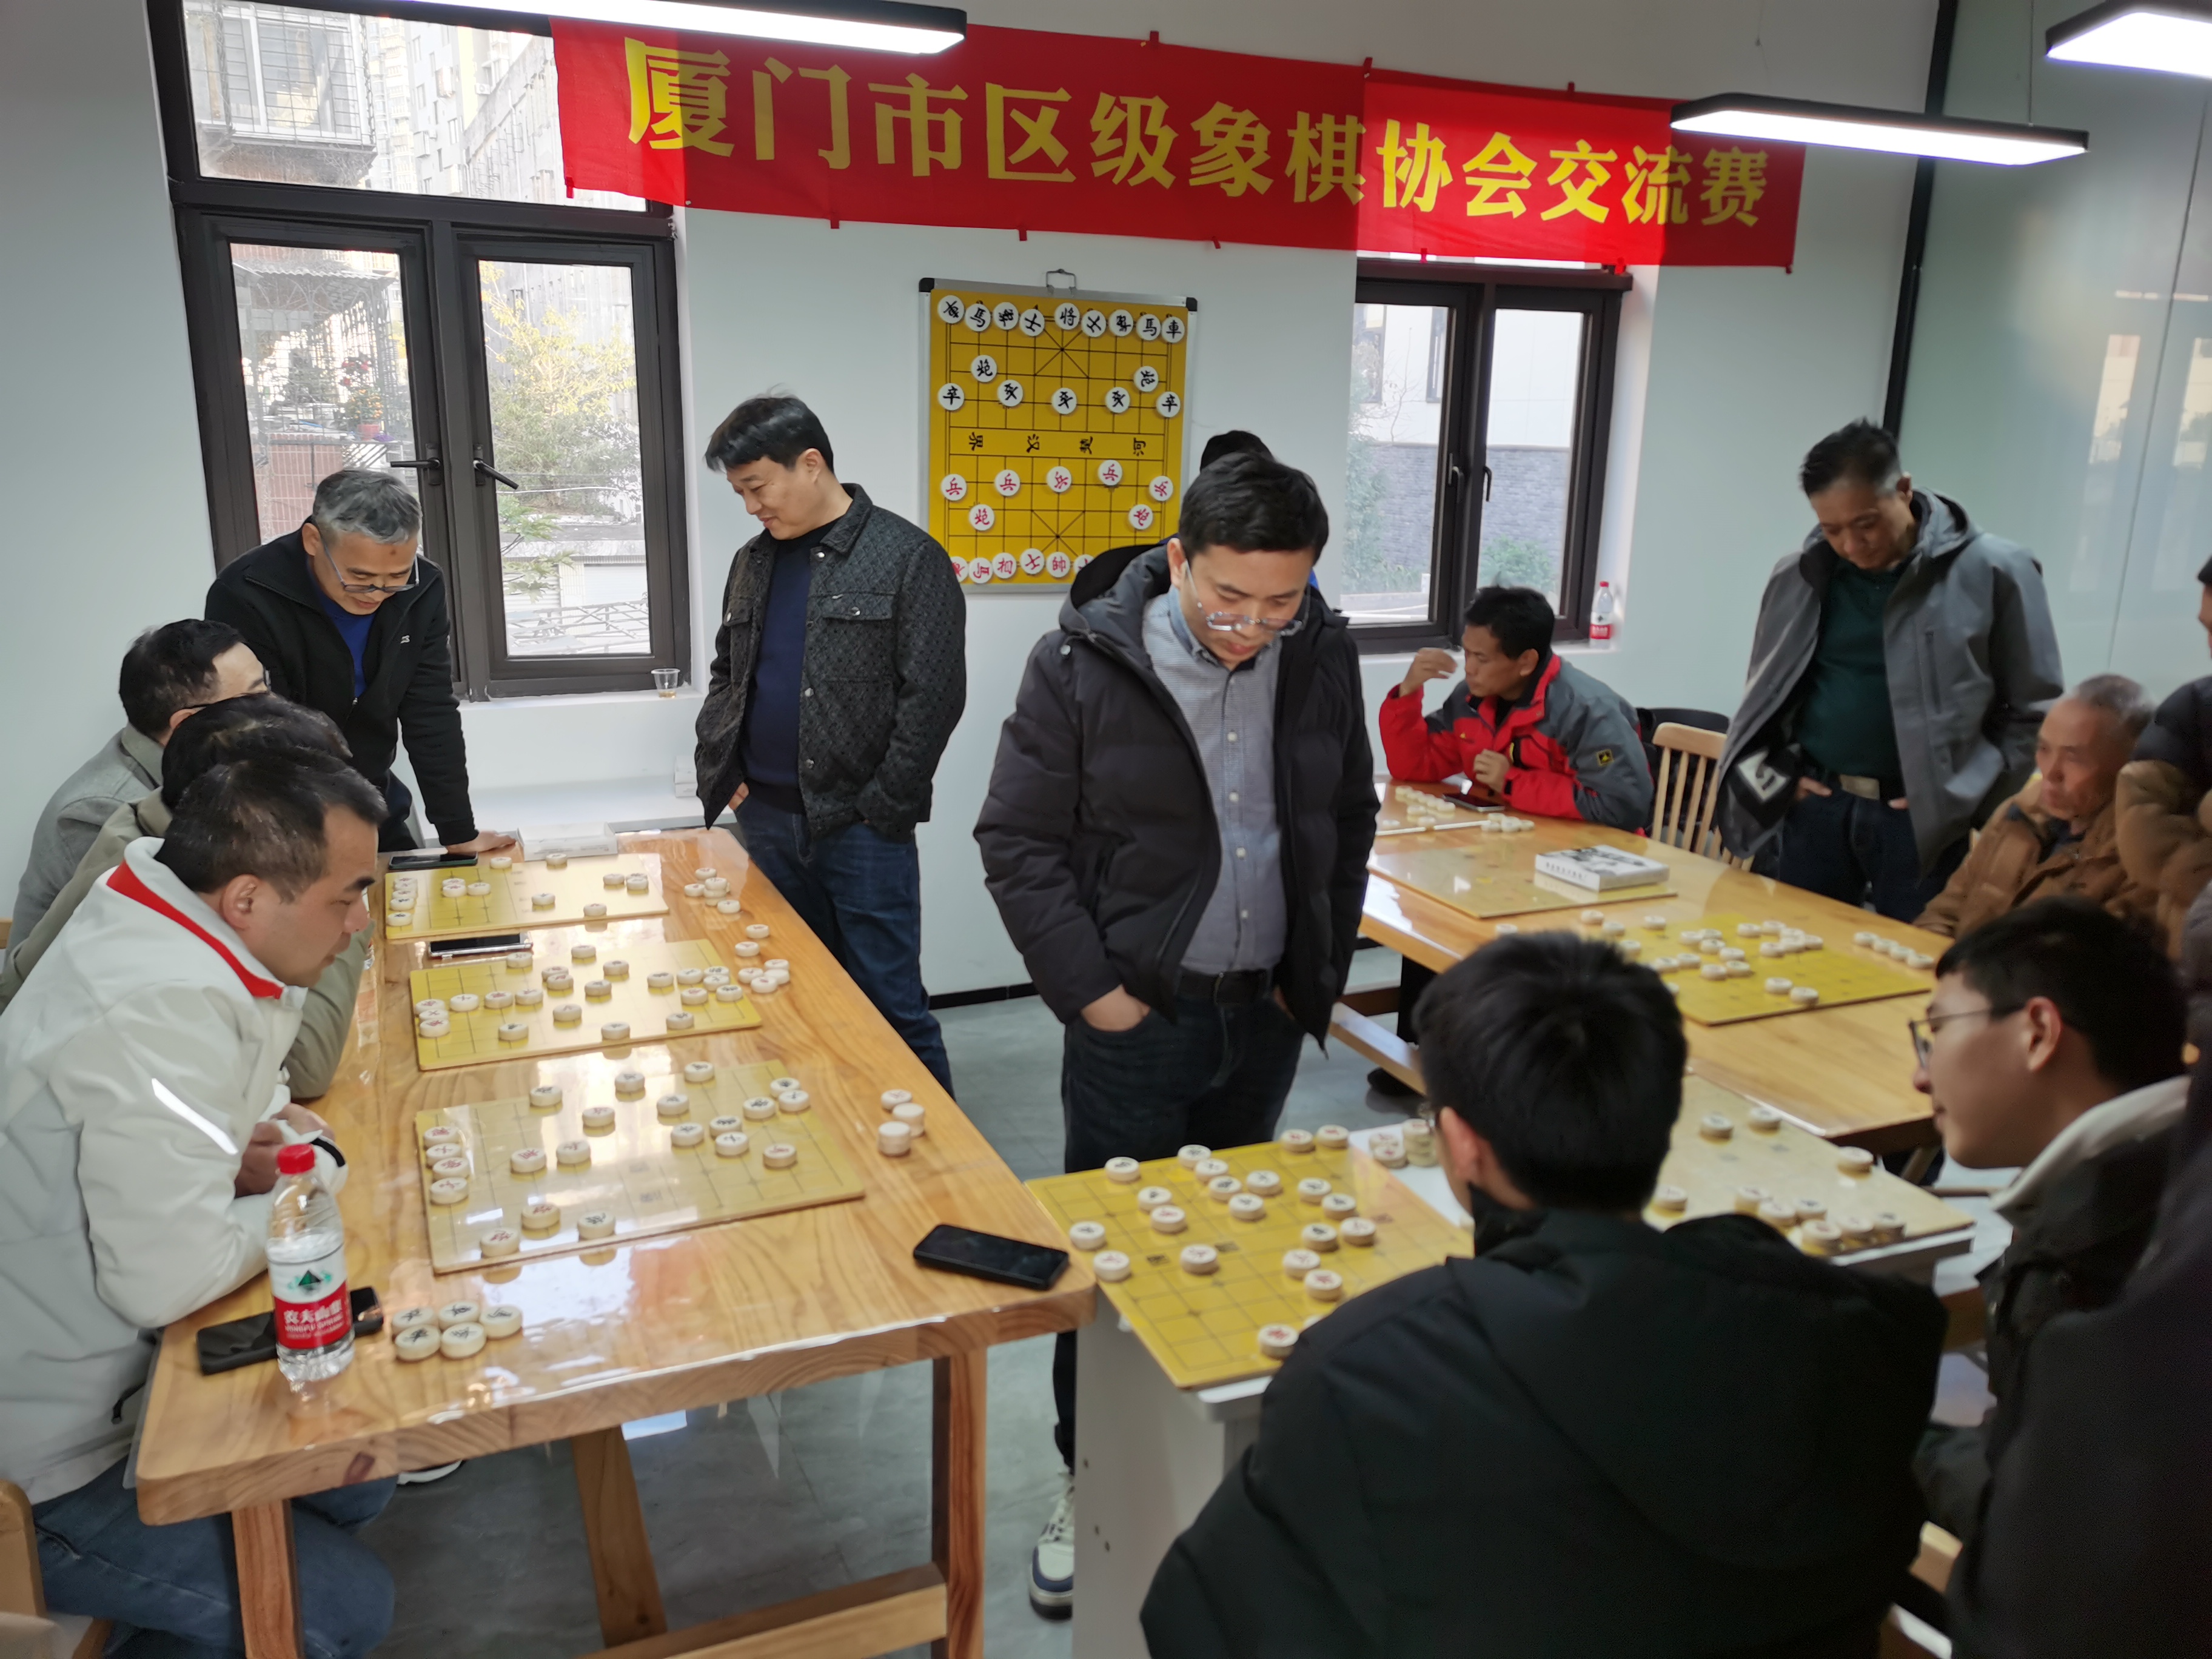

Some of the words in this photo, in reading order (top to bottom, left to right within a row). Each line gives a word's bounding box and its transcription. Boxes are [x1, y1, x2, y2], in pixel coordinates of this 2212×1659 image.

[624, 36, 1768, 227] 厦门市区级象棋协会交流赛
[1054, 472, 1068, 489] 兵
[1103, 464, 1118, 481] 兵
[946, 478, 962, 495] 兵
[1000, 474, 1016, 491] 兵
[1155, 481, 1168, 497] 兵
